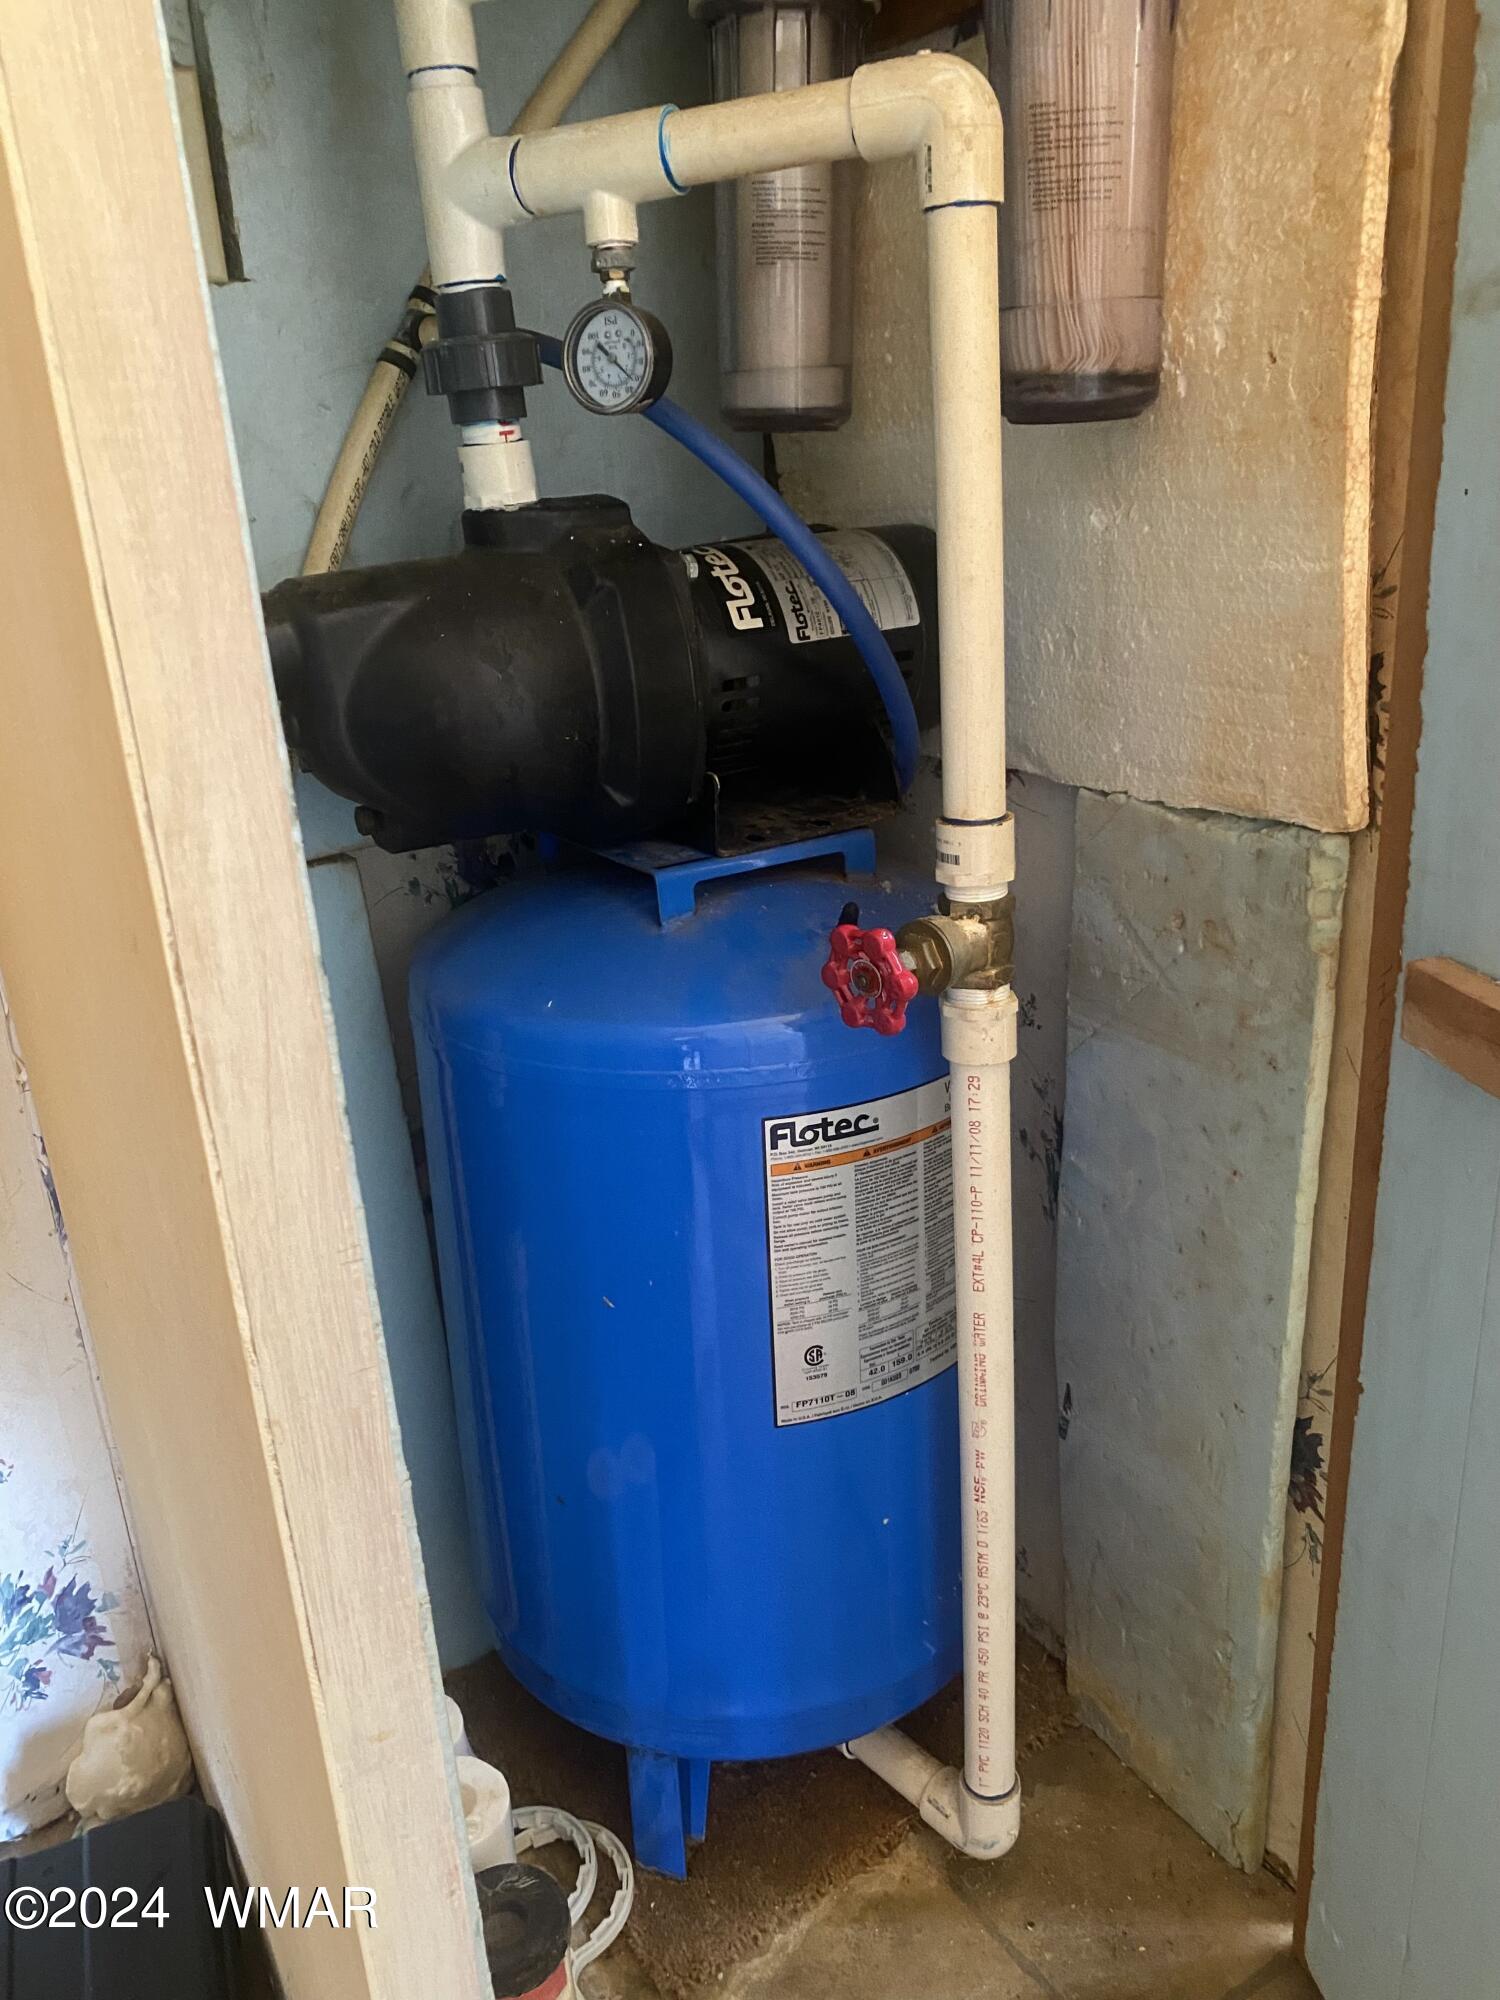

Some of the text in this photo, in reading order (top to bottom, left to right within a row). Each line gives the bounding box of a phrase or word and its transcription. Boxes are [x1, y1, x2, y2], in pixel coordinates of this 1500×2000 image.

[785, 580, 811, 641] Flotec
[967, 1075, 981, 1111] 17:29
[770, 1114, 879, 1150] Flotec
[969, 1120, 982, 1177] 11/11/08
[970, 1186, 983, 1243] CP-110-P
[972, 1251, 984, 1292] EXT#4L
[973, 1312, 985, 1346] WATER
[869, 1365, 886, 1376] 42.0
[974, 1353, 987, 1407] DRINKING
[976, 1553, 989, 1578] ASTM
[978, 1624, 990, 1643] PSI
[977, 1648, 990, 1666] 450
[978, 1671, 990, 1685] PR
[978, 1688, 990, 1701] 40
[978, 1704, 990, 1723] SCH
[978, 1727, 990, 1751] 1120
[978, 1755, 990, 1773] PVC
